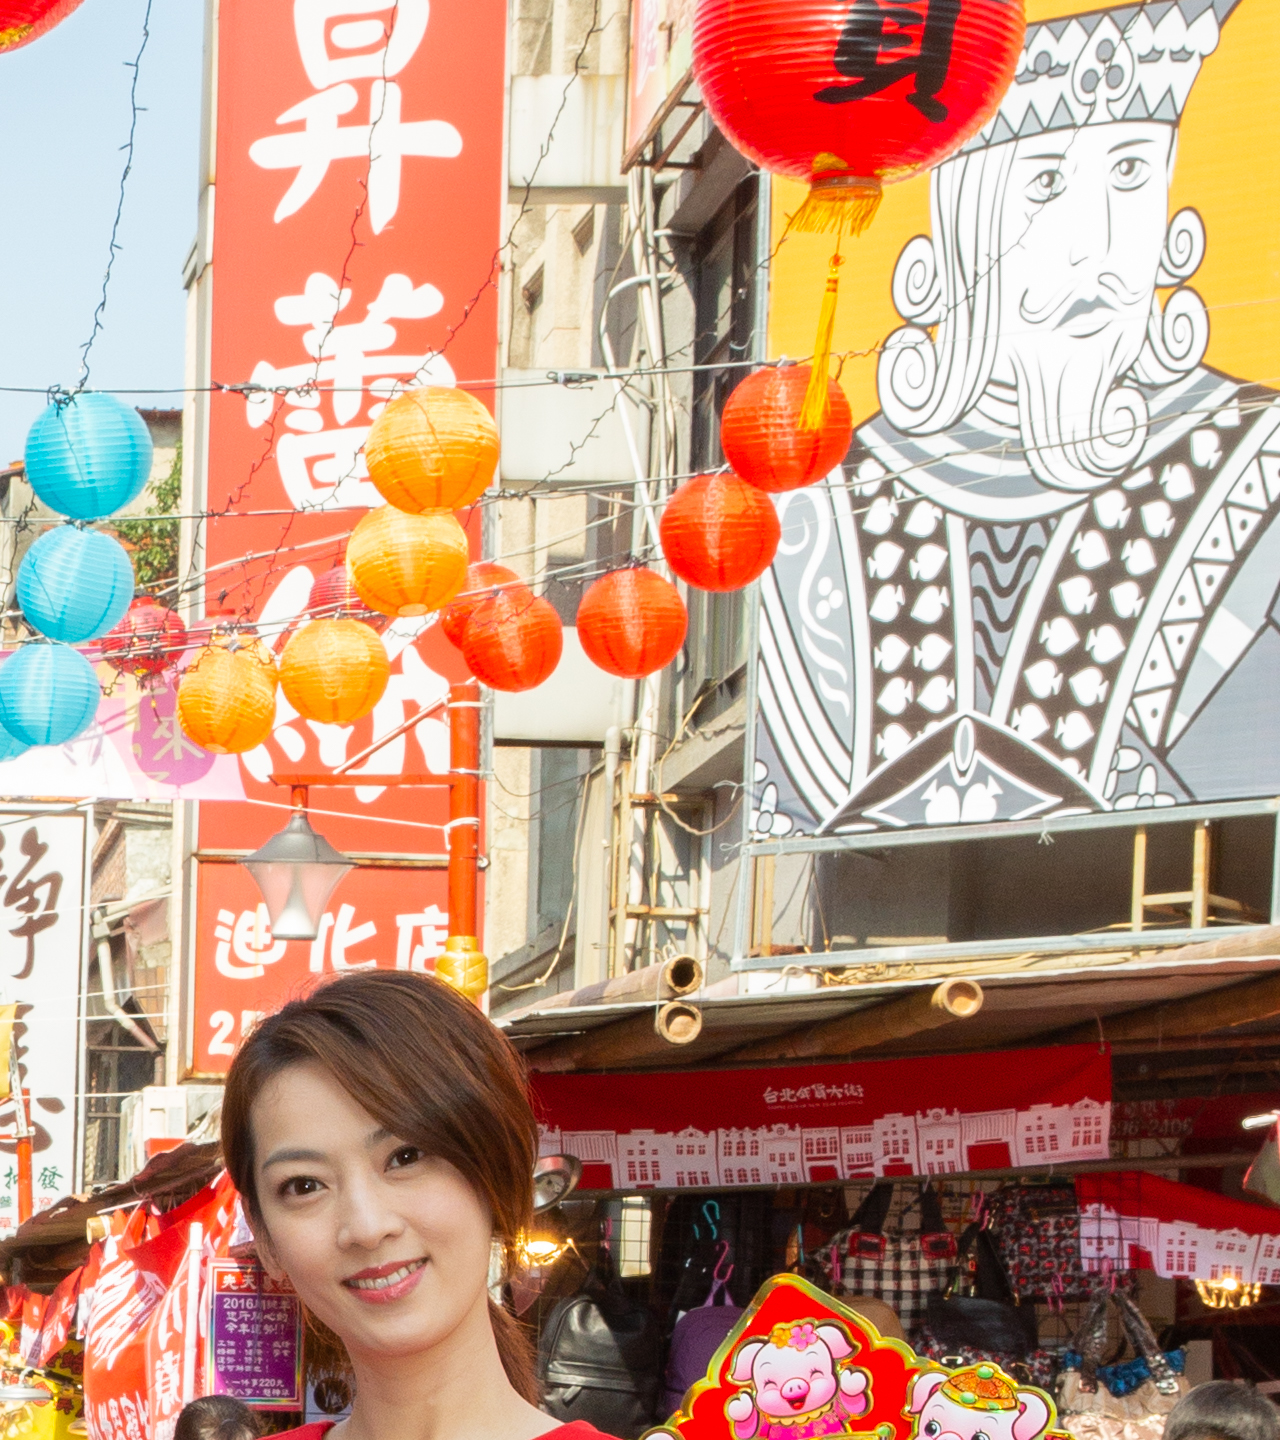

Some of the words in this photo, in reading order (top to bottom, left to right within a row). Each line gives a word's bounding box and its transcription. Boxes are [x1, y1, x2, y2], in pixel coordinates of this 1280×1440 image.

[762, 1083, 864, 1104] 台北年貨大街
